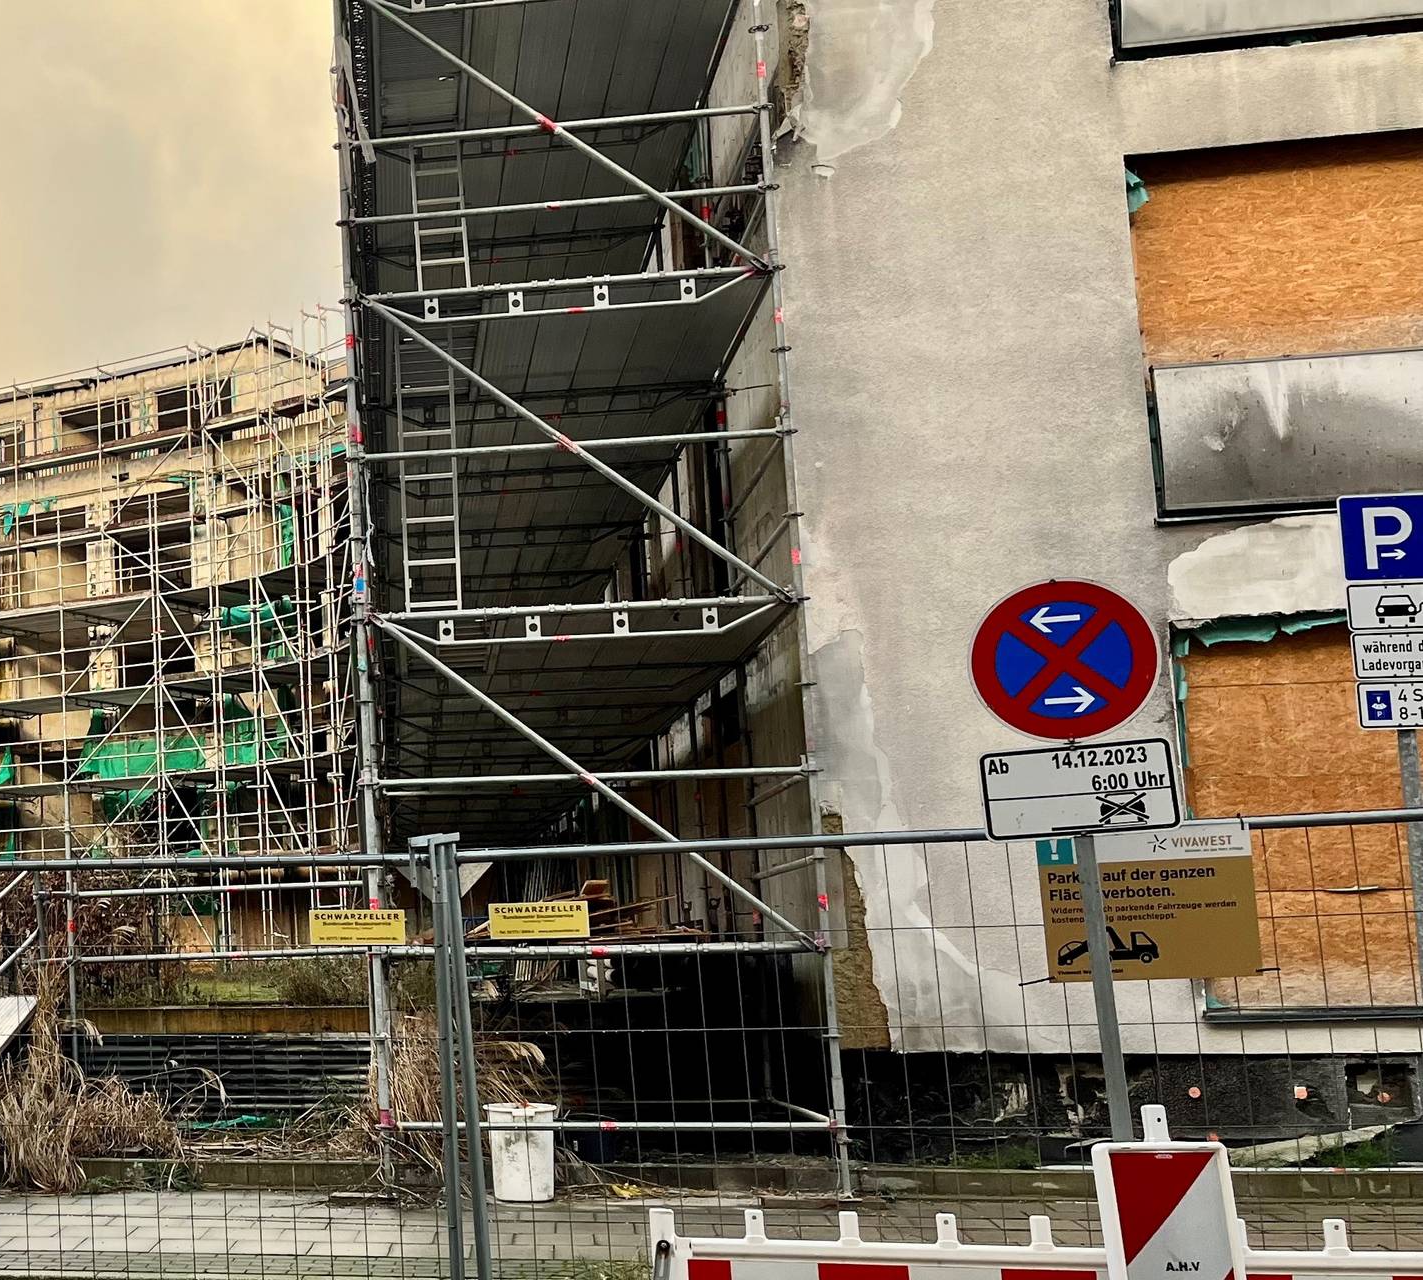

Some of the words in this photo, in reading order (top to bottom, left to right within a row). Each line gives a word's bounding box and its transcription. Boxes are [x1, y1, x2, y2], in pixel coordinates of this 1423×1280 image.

[1362, 506, 1413, 570] P
[1362, 639, 1413, 654] während
[1398, 689, 1408, 702] 4
[1413, 688, 1423, 702] S
[1399, 706, 1423, 720] 8-1
[988, 759, 1009, 775] Ab
[1052, 746, 1148, 770] 14.12.2023
[1091, 772, 1128, 791] 6:00
[1134, 771, 1166, 788] Uhr
[1171, 835, 1233, 848] VIVAWEST
[1048, 872, 1080, 885] Park
[1102, 869, 1127, 882] auf
[1130, 868, 1156, 881] der
[1159, 866, 1215, 881] ganzen
[1049, 888, 1082, 902] Fläc
[1102, 885, 1176, 900] verboten.
[494, 904, 582, 914] SCHWARZFELLER
[1051, 904, 1113, 915] Widerrech
[1115, 903, 1155, 913] parkende
[1157, 901, 1202, 911] Fahrzeuge
[1204, 900, 1237, 909] werden
[314, 913, 400, 921] SCHWARZFELLER
[1051, 913, 1115, 925] kostenpig
[1165, 1261, 1200, 1272] A.H.V
